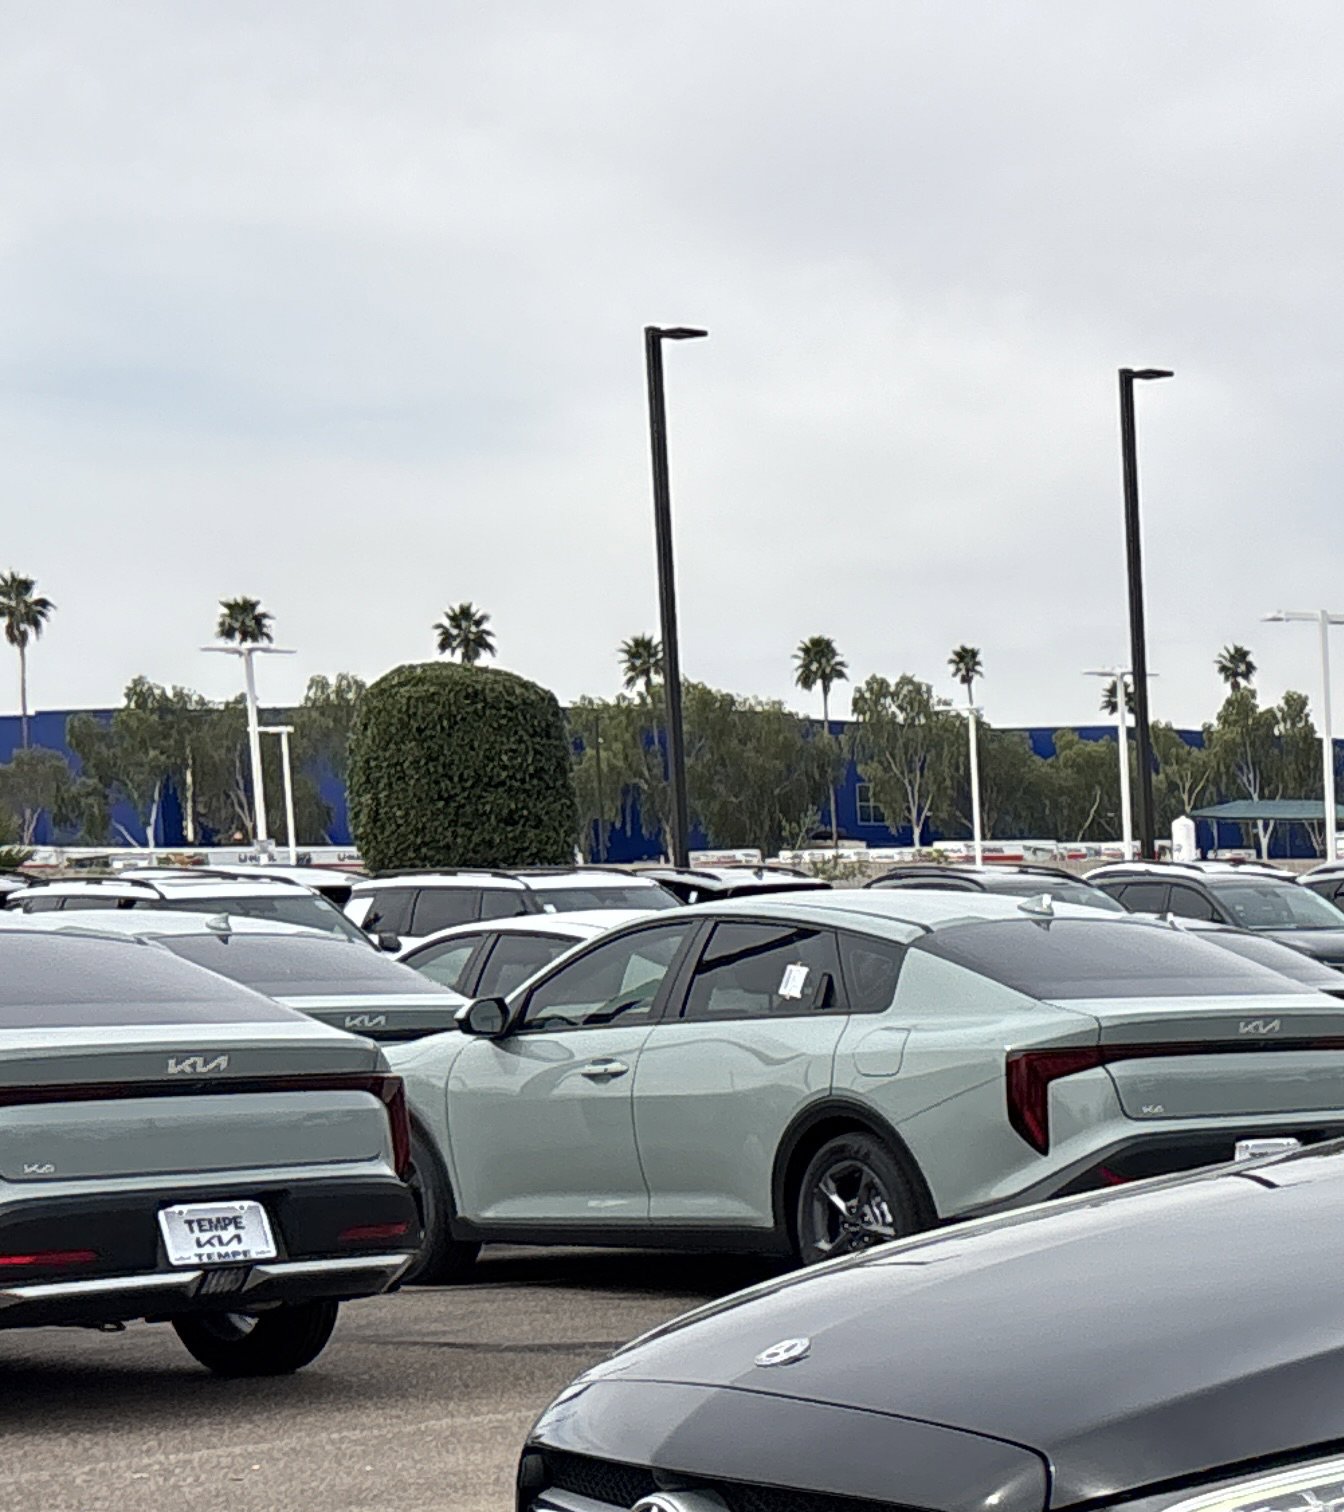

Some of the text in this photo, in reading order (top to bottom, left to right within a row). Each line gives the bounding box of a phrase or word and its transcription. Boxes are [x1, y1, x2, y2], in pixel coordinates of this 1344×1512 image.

[344, 1014, 386, 1028] KIA
[1238, 1019, 1281, 1034] KIA
[167, 1054, 229, 1074] KIA
[183, 1215, 246, 1234] TEMPE
[195, 1233, 243, 1249] KIA
